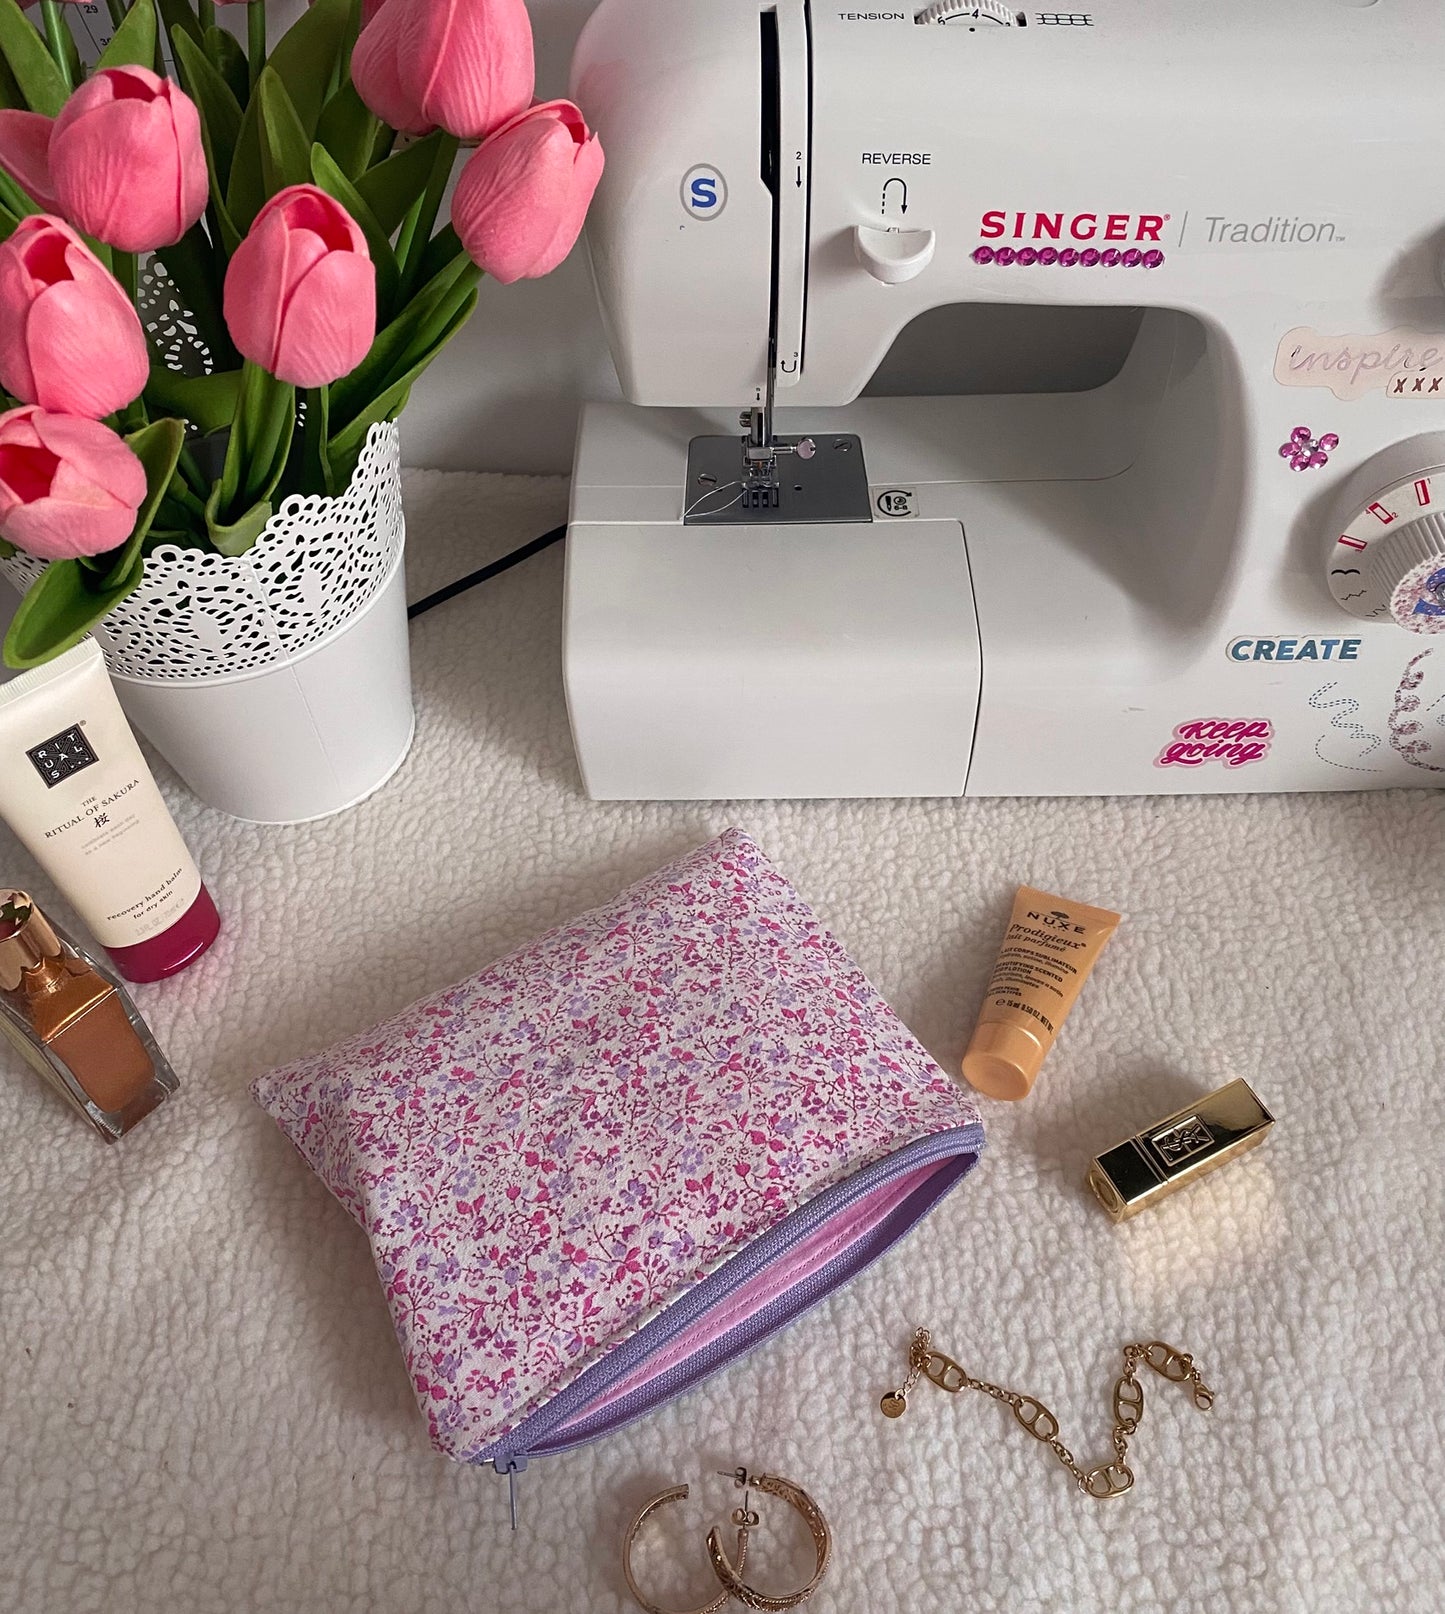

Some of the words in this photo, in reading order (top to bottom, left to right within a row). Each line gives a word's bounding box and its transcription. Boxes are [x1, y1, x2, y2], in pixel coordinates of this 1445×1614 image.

[83, 5, 98, 14] 29
[971, 8, 979, 19] 4
[795, 152, 802, 160] 2
[862, 153, 931, 165] REVERSE
[690, 178, 718, 208] S
[980, 211, 1164, 241] SINGER
[1205, 217, 1336, 242] Tradition
[1231, 639, 1361, 661] CREATE
[1160, 739, 1265, 766] going
[44, 815, 85, 838] RITUAL
[85, 803, 100, 816] OF
[101, 779, 140, 807] SAKURA
[81, 795, 97, 807] THE
[107, 901, 144, 921] recovery
[145, 884, 165, 902] hand
[166, 868, 182, 886] balm
[133, 911, 144, 919] for
[146, 902, 158, 912] dry
[159, 890, 173, 903] skin
[1027, 911, 1086, 935] NUXE
[1023, 936, 1066, 953] parfumé
[1008, 967, 1032, 975] LOTION
[1035, 951, 1078, 975] SUBLIMATEUR
[1034, 966, 1063, 983] SCENTED
